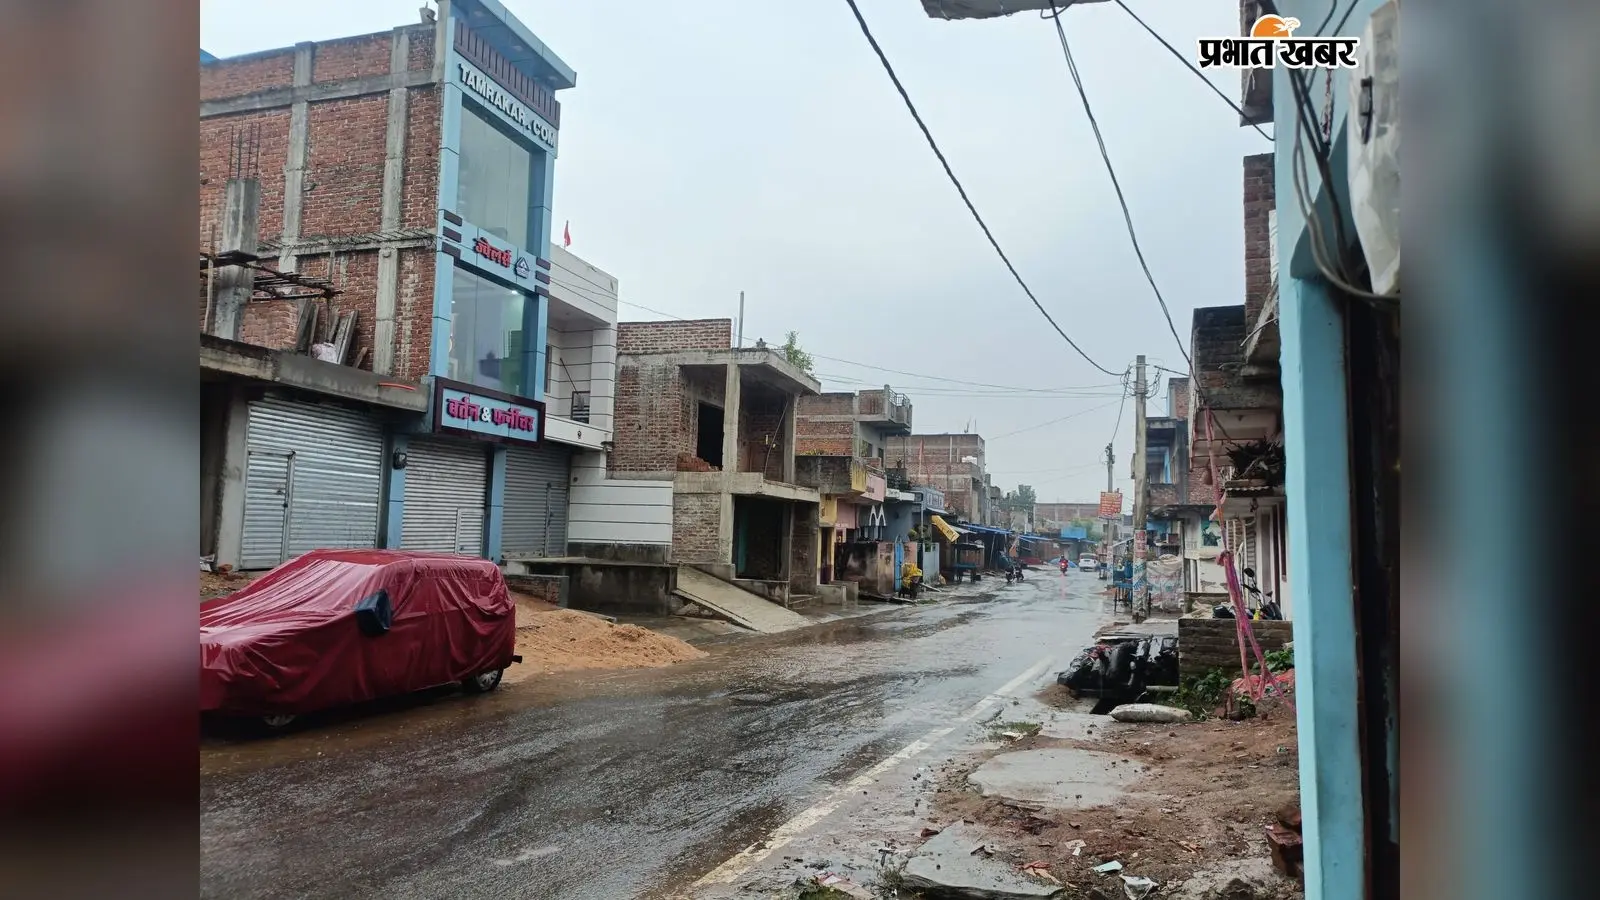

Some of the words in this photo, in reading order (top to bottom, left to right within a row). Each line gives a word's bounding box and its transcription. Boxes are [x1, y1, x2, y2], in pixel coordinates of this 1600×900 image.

[447, 395, 480, 421] बर्तन
[481, 406, 492, 423] &
[492, 407, 535, 432] फर्नीचर
